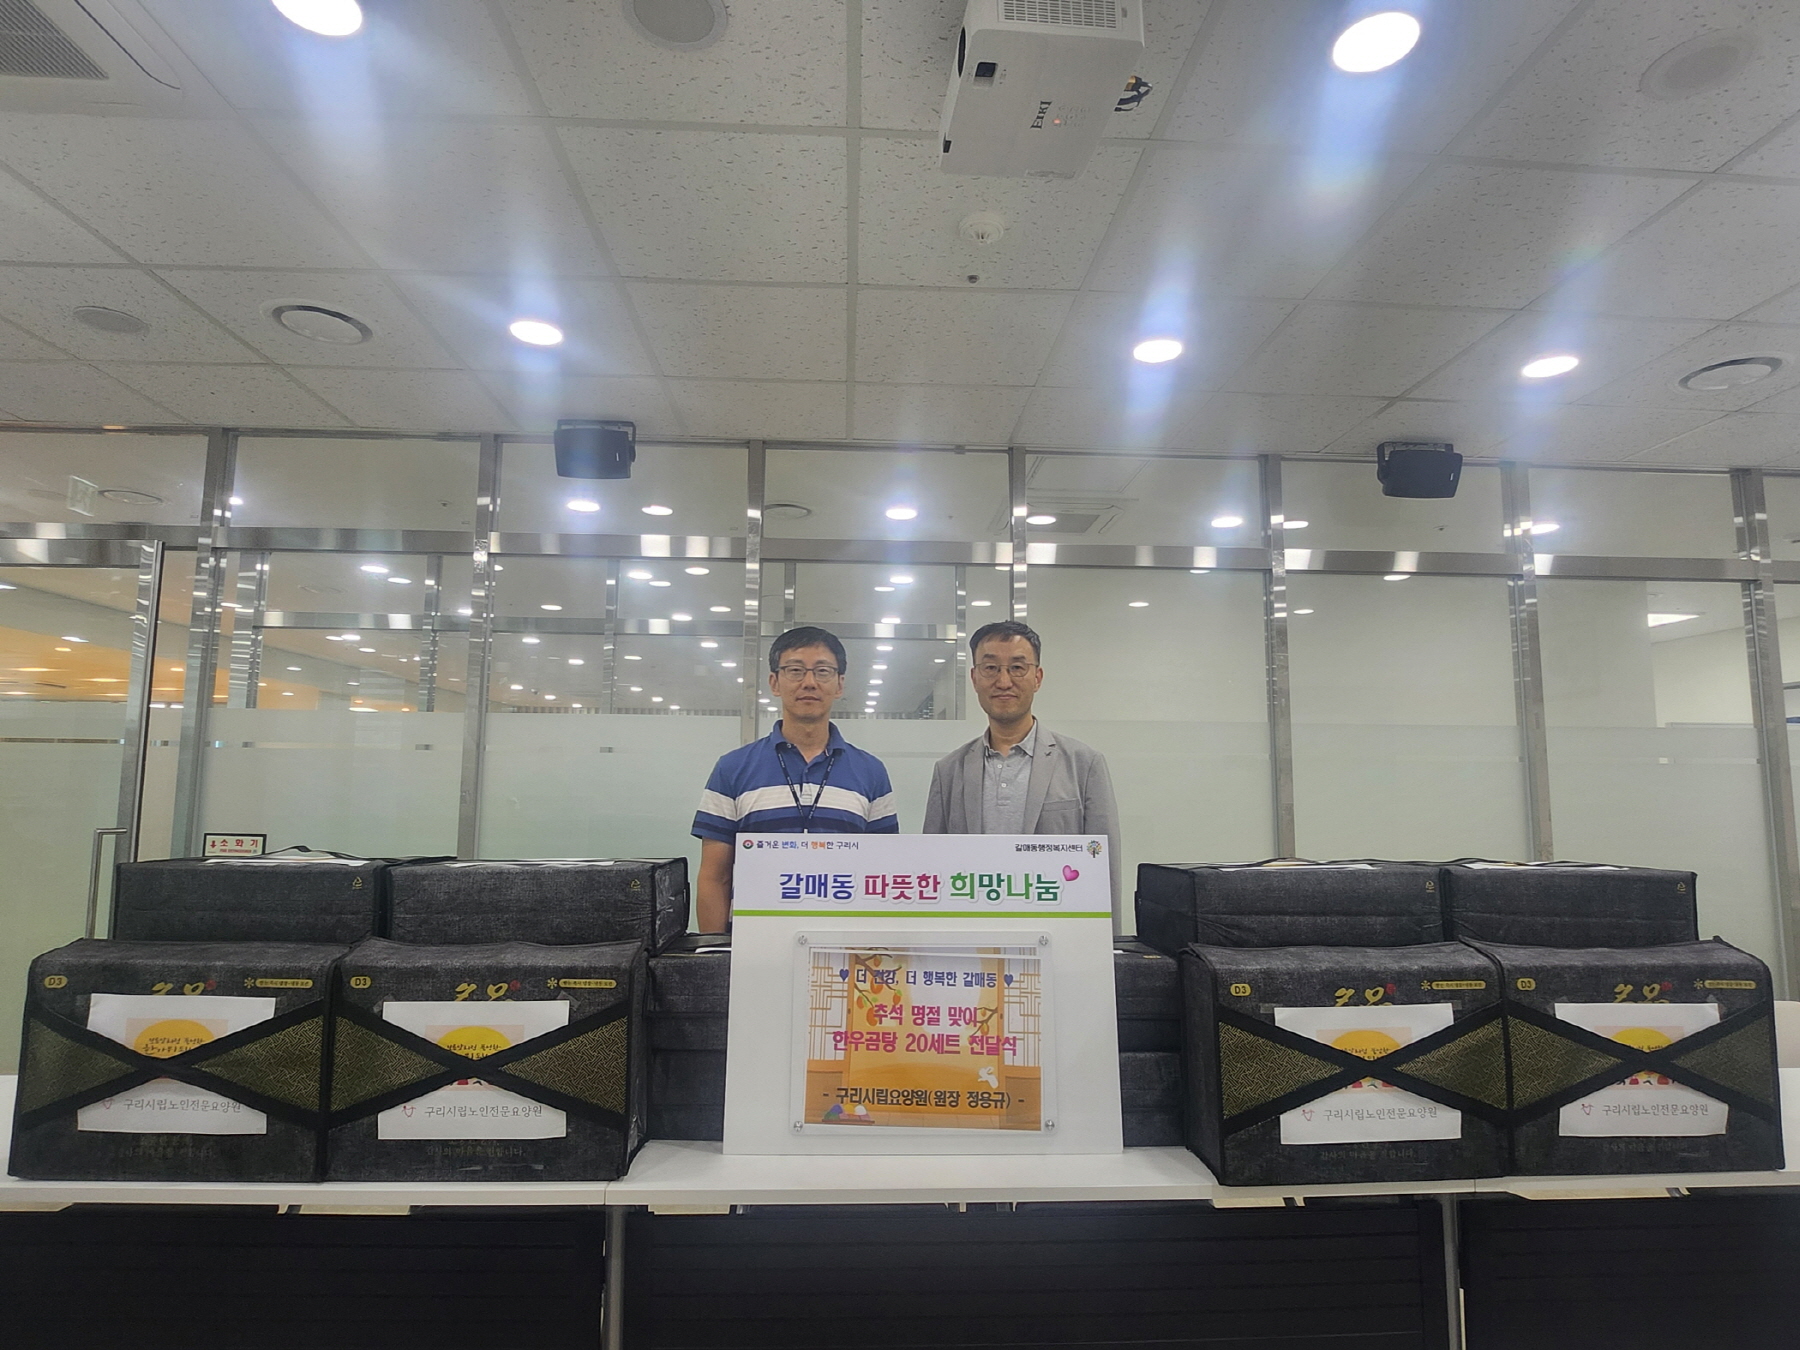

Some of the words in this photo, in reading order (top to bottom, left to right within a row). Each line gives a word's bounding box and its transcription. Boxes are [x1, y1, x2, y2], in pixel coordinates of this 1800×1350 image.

[1030, 101, 1052, 129] EIKI
[781, 841, 799, 849] 변화,
[801, 841, 809, 849] 더
[811, 841, 834, 849] 행복한
[836, 841, 859, 849] 구리시
[1015, 843, 1083, 852] 갈매동행정복지센터
[779, 873, 854, 900] 갈매동
[864, 872, 940, 900] 따뜻한
[950, 871, 1060, 901] 희망나눔
[48, 977, 63, 986] D3
[354, 977, 368, 987] D3
[856, 969, 867, 984] 더
[874, 970, 899, 986] 건강,
[905, 970, 917, 985] 더
[923, 971, 957, 987] 행복한
[963, 972, 997, 988] 갈매동
[1520, 980, 1533, 990] D3
[1234, 985, 1248, 996] D3
[873, 1004, 903, 1026] 추석
[911, 1005, 941, 1027] 명절
[947, 1007, 978, 1028] 맞이
[832, 1030, 898, 1053] 한우곰탕
[905, 1033, 960, 1055] 20세트
[969, 1035, 1018, 1057] 전달식
[124, 1098, 241, 1114] 구리시립노인전문요양원
[966, 1091, 1011, 1109] 정용규)
[425, 1105, 543, 1118] 구리시립노인전문요양원
[1323, 1104, 1438, 1121] 구리시립노인전문요양원
[1602, 1103, 1709, 1116] 구리시립노인전문요양원
